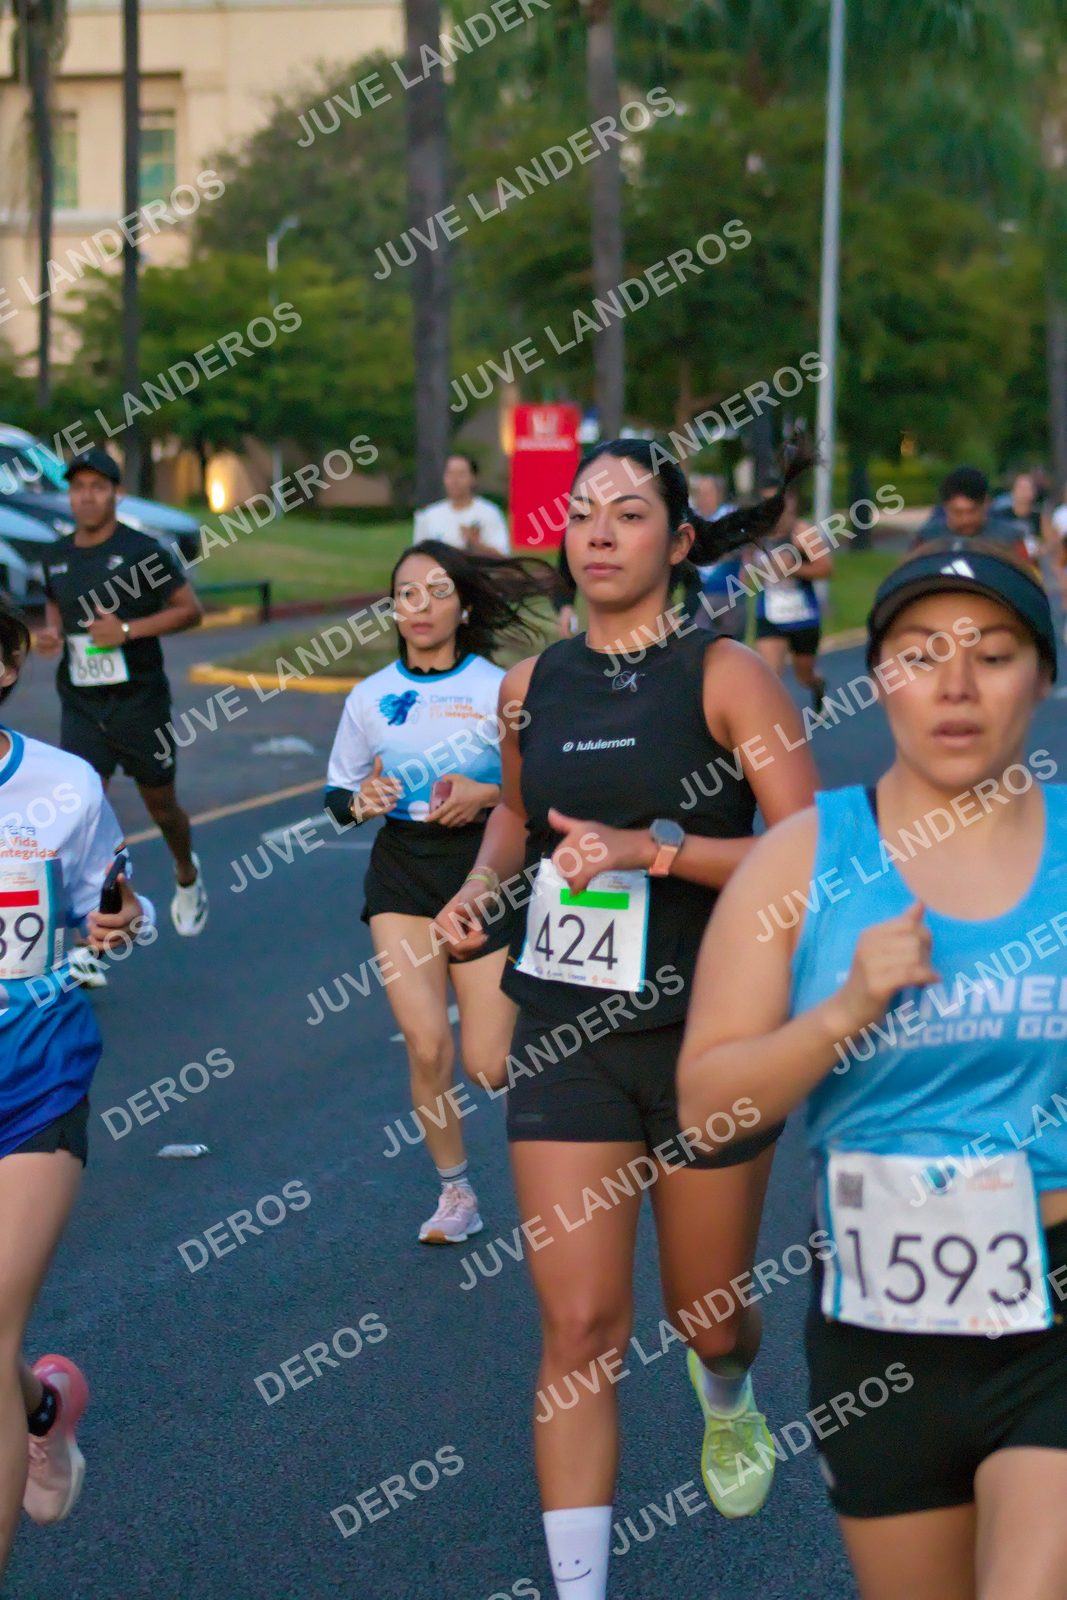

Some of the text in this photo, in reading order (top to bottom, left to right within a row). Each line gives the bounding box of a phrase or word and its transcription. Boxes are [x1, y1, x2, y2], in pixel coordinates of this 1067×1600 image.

[576, 737, 636, 751] lululemon
[10, 836, 38, 848] Vida
[534, 911, 618, 971] 424
[845, 1224, 1033, 1307] 1593
